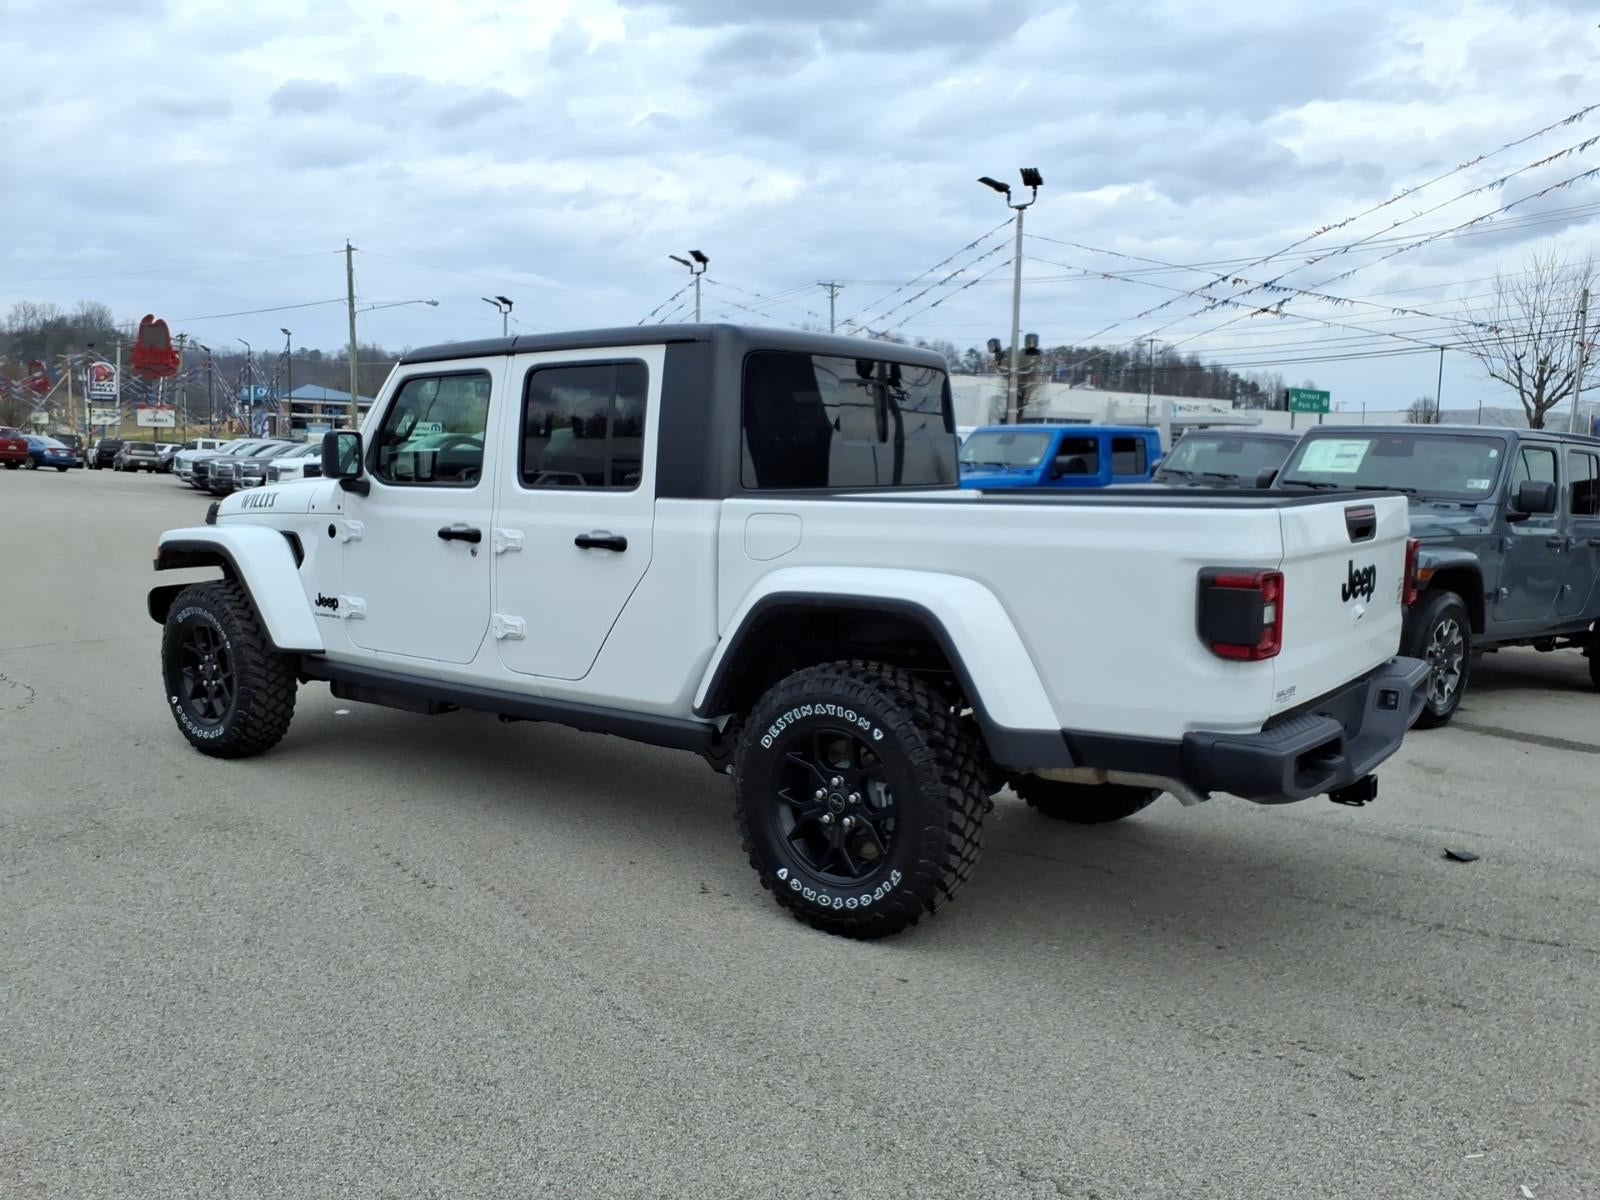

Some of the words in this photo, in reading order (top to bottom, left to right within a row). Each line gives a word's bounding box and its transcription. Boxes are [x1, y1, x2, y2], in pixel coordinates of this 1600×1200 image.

[241, 492, 279, 509] WILLYS
[1342, 560, 1376, 603] Jeep
[315, 592, 339, 611] Jeep
[760, 703, 871, 749] DESTINATION
